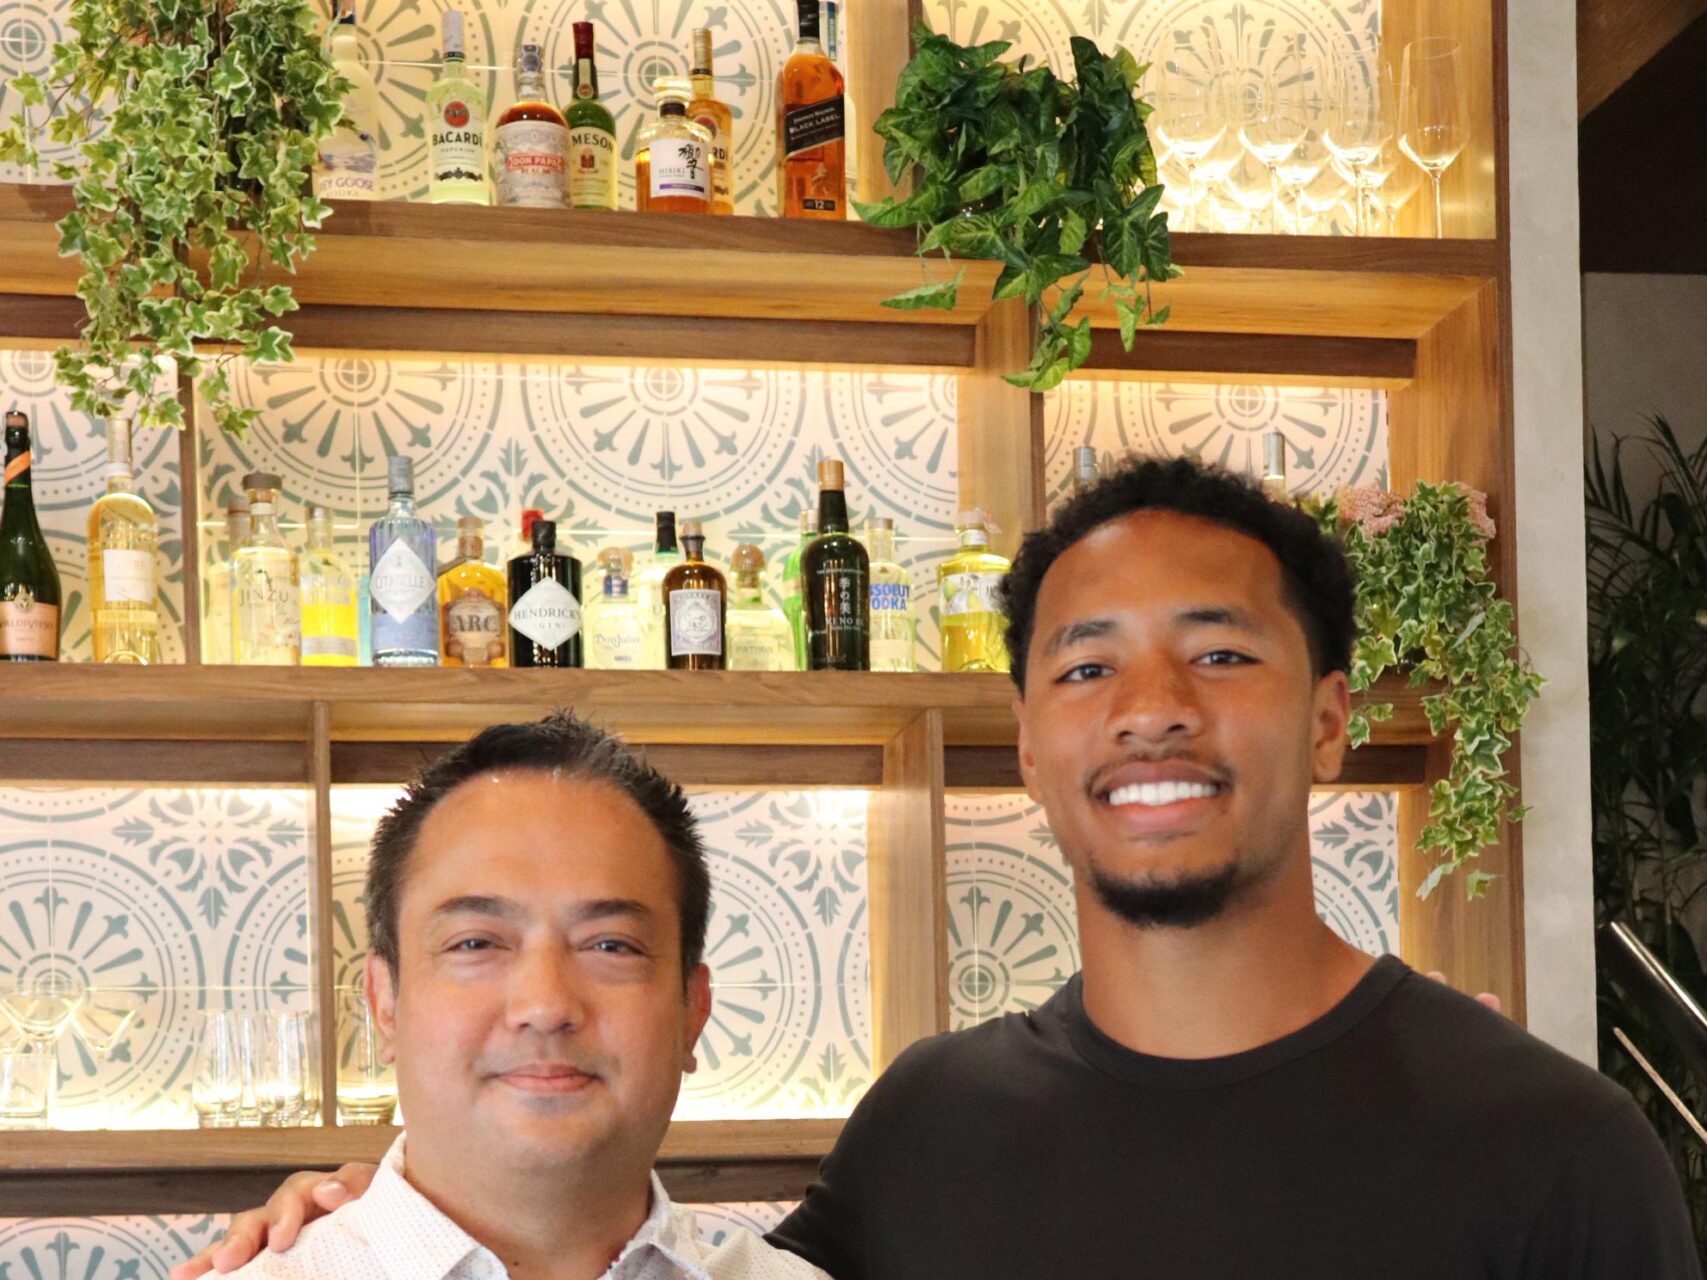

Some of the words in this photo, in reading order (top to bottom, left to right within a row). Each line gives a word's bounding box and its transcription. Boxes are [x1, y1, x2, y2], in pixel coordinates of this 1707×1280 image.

[789, 121, 814, 134] BLACK
[815, 114, 840, 126] LABEL
[571, 133, 613, 153] MESON
[513, 156, 531, 166] DON
[815, 200, 824, 209] 12
[239, 588, 290, 607] JINZU
[869, 583, 910, 598] SOLUT
[871, 597, 907, 611] ODKA
[839, 617, 853, 625] NO
